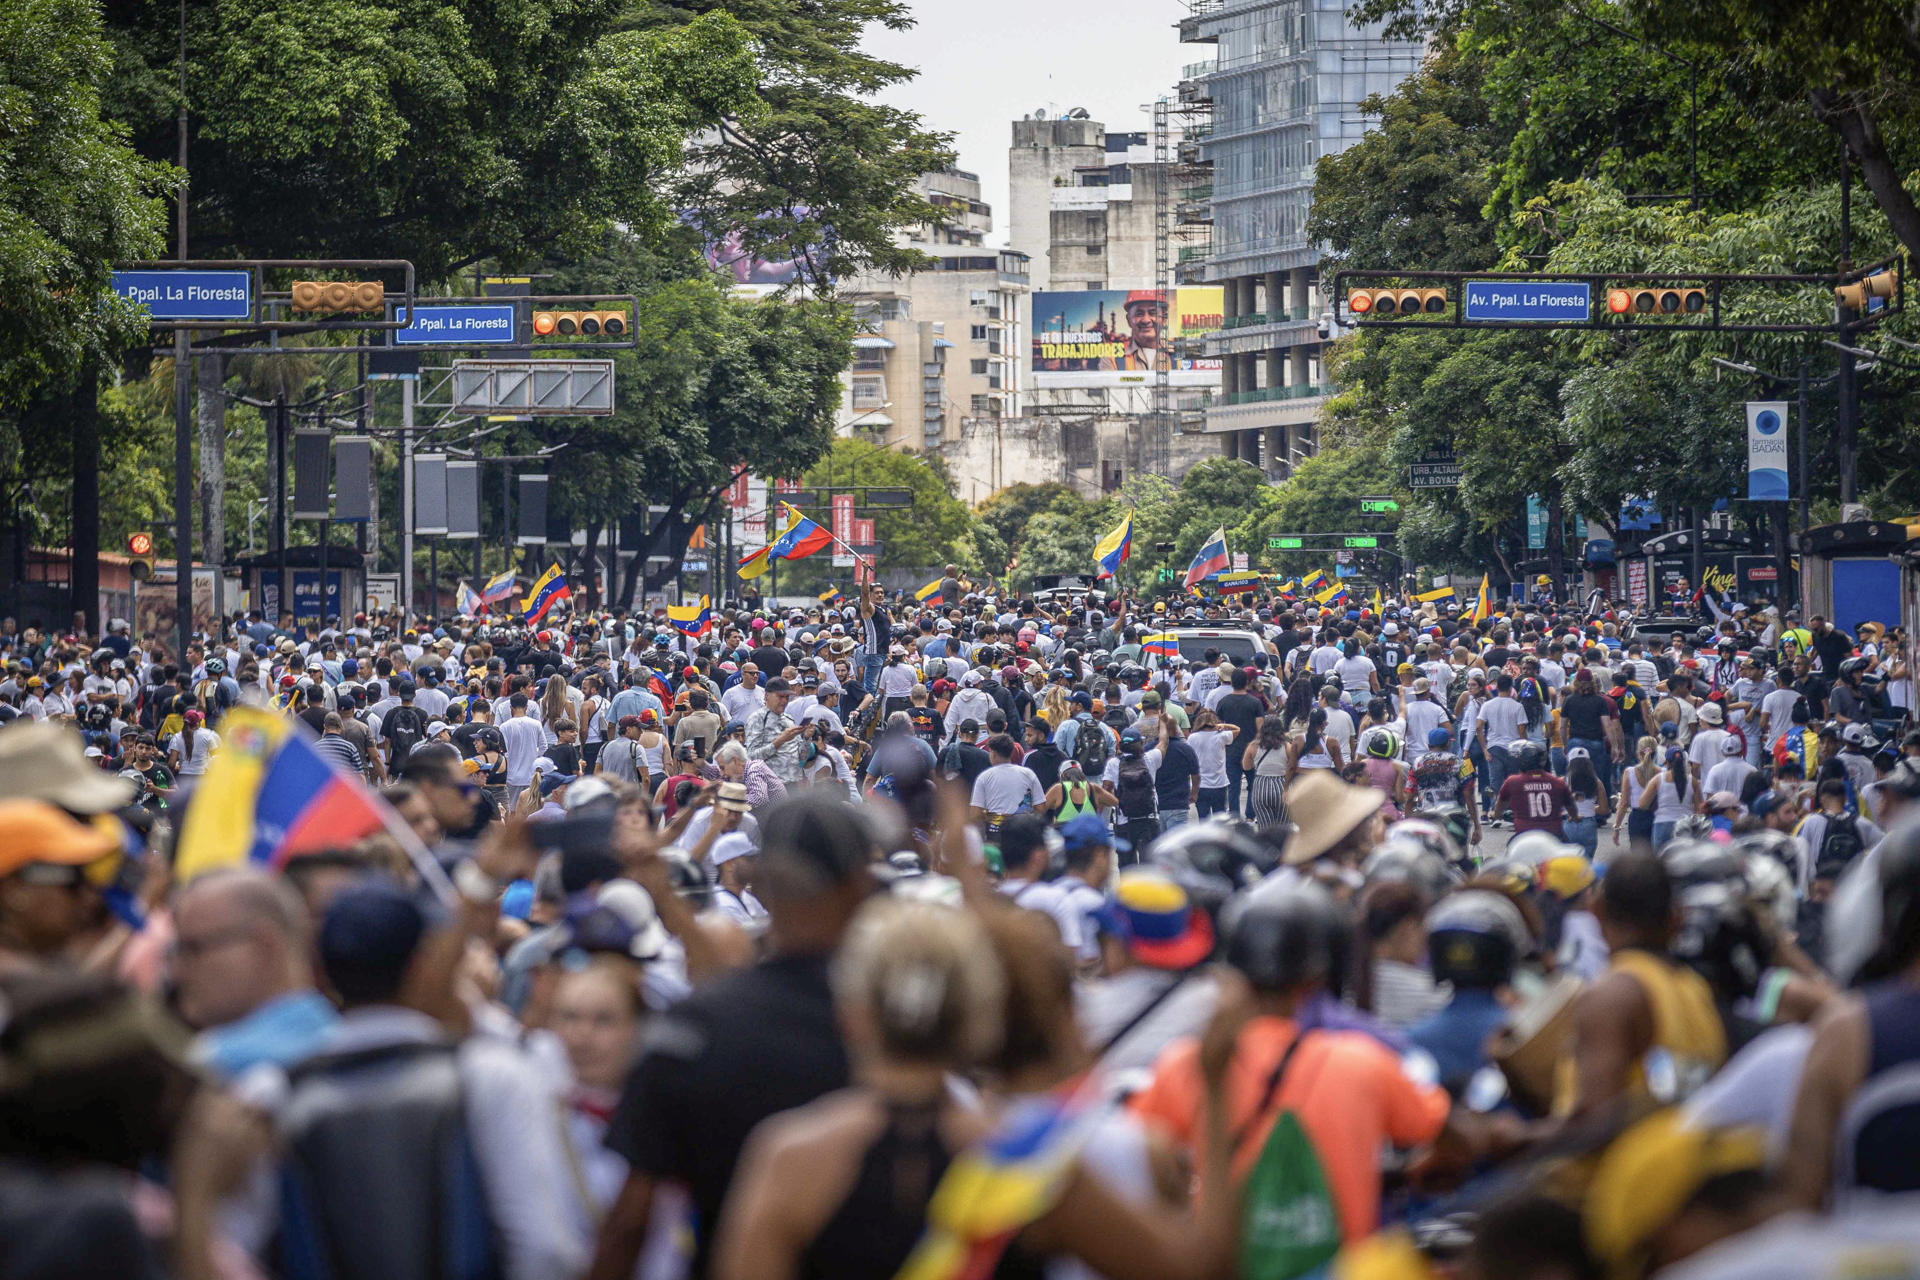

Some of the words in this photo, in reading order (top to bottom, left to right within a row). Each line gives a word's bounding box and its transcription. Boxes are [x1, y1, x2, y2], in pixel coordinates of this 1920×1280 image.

[128, 286, 163, 304] Ppal.
[166, 286, 184, 300] La
[188, 286, 245, 301] Floresta
[1470, 294, 1488, 306] Av.
[1492, 294, 1520, 309] Ppal.
[1523, 294, 1537, 306] La
[1540, 294, 1585, 306] Floresta
[420, 318, 446, 333] Ppal.
[449, 317, 462, 329] La
[465, 317, 508, 329] Floresta
[1041, 342, 1125, 359] TRABAJADORES
[1361, 502, 1375, 512] 04
[1159, 568, 1174, 582] 24
[1386, 650, 1398, 667] 0
[1528, 792, 1552, 817] 10
